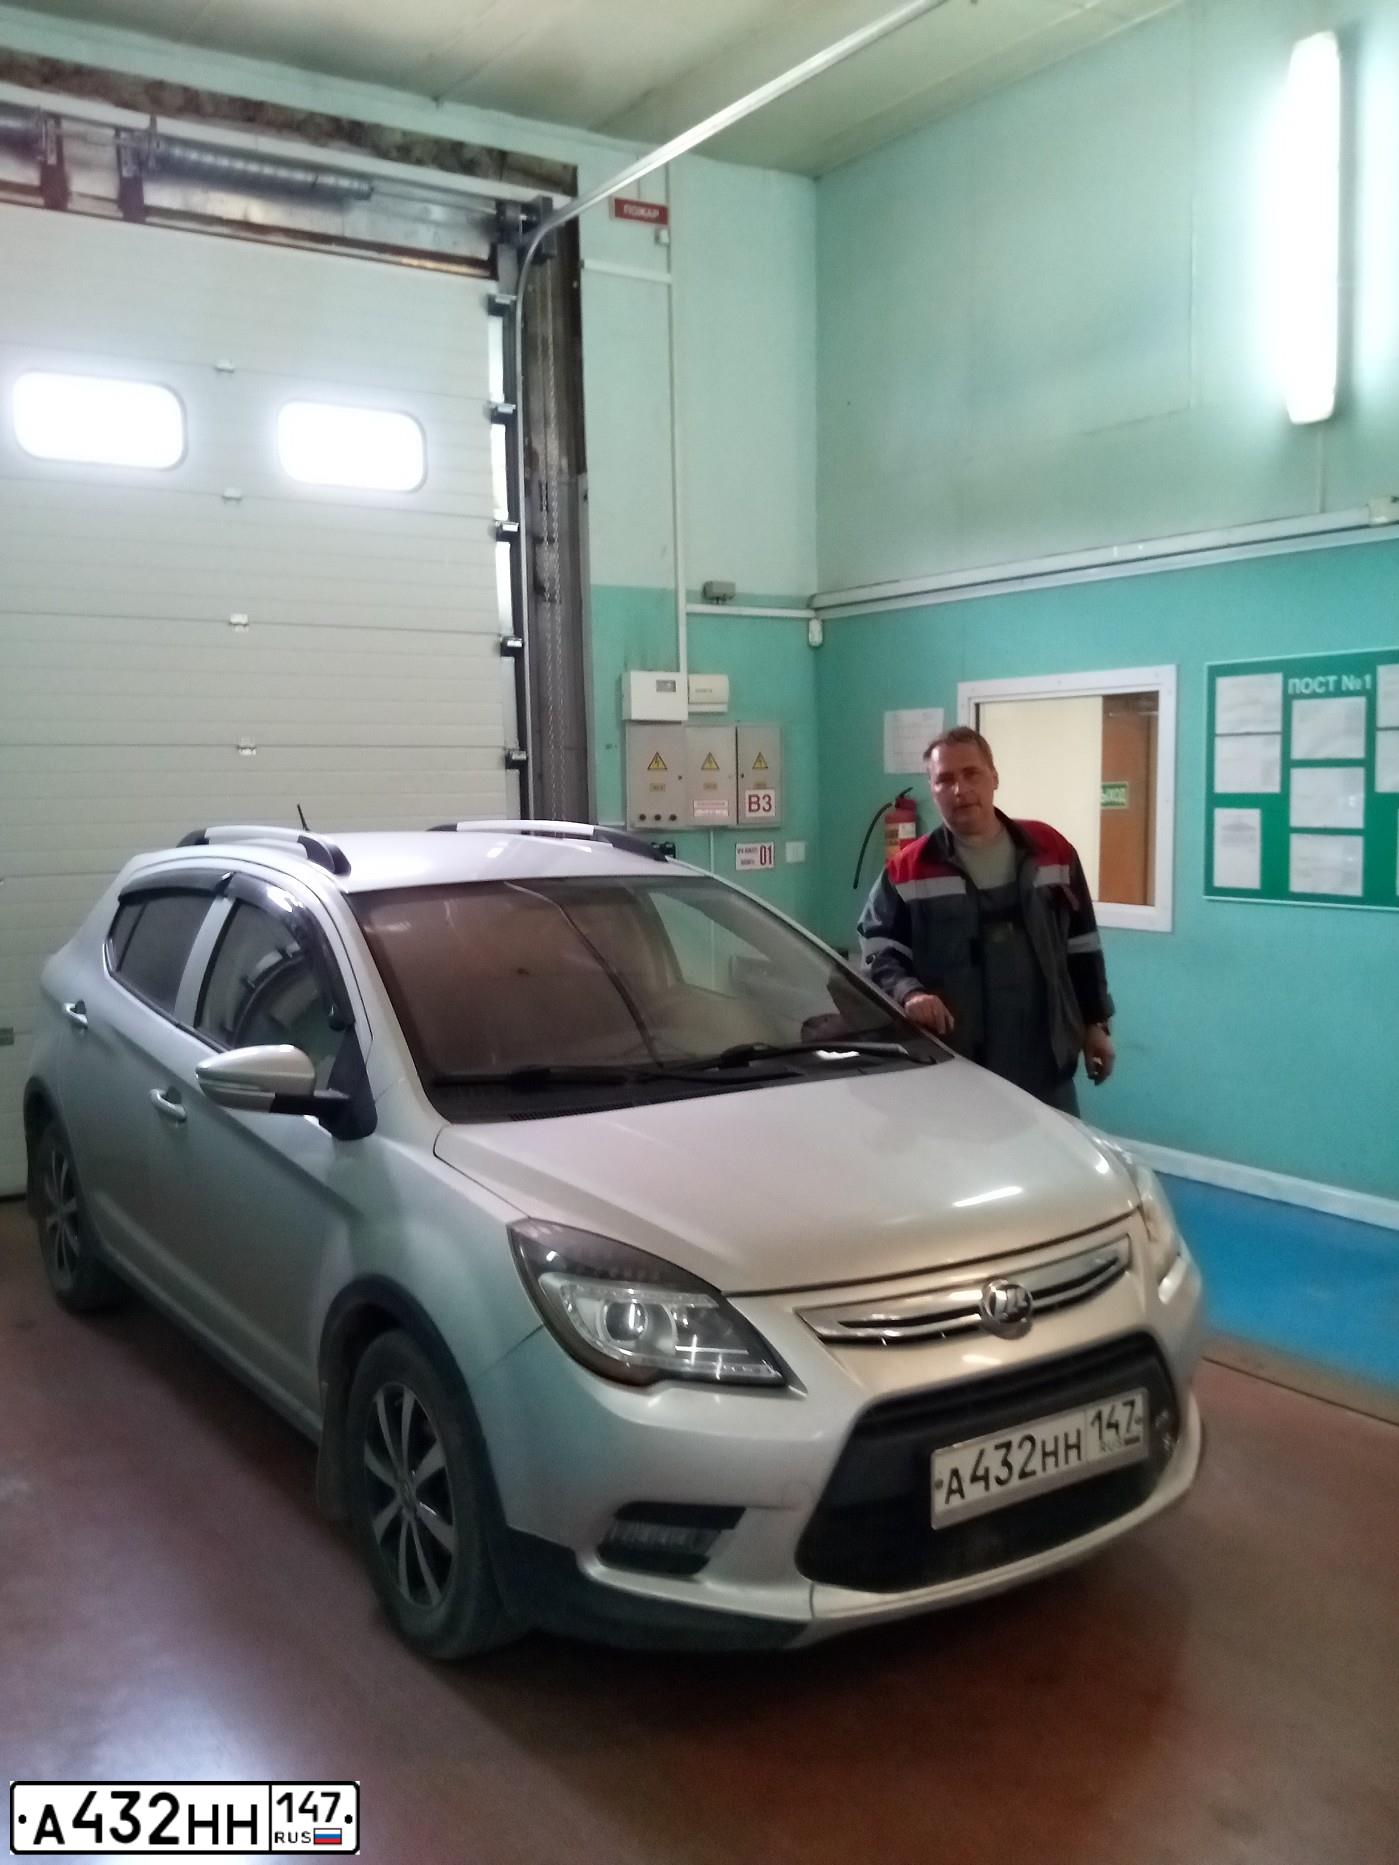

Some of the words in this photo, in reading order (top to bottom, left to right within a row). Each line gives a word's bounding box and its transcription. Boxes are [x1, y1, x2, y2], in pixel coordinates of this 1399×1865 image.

[623, 203, 660, 218] ПОЖАР
[1287, 674, 1338, 695] ПОСТ
[1341, 673, 1372, 691] №1
[760, 844, 772, 866] 01
[944, 1428, 1082, 1505] А432НН
[1090, 1398, 1136, 1442] 147
